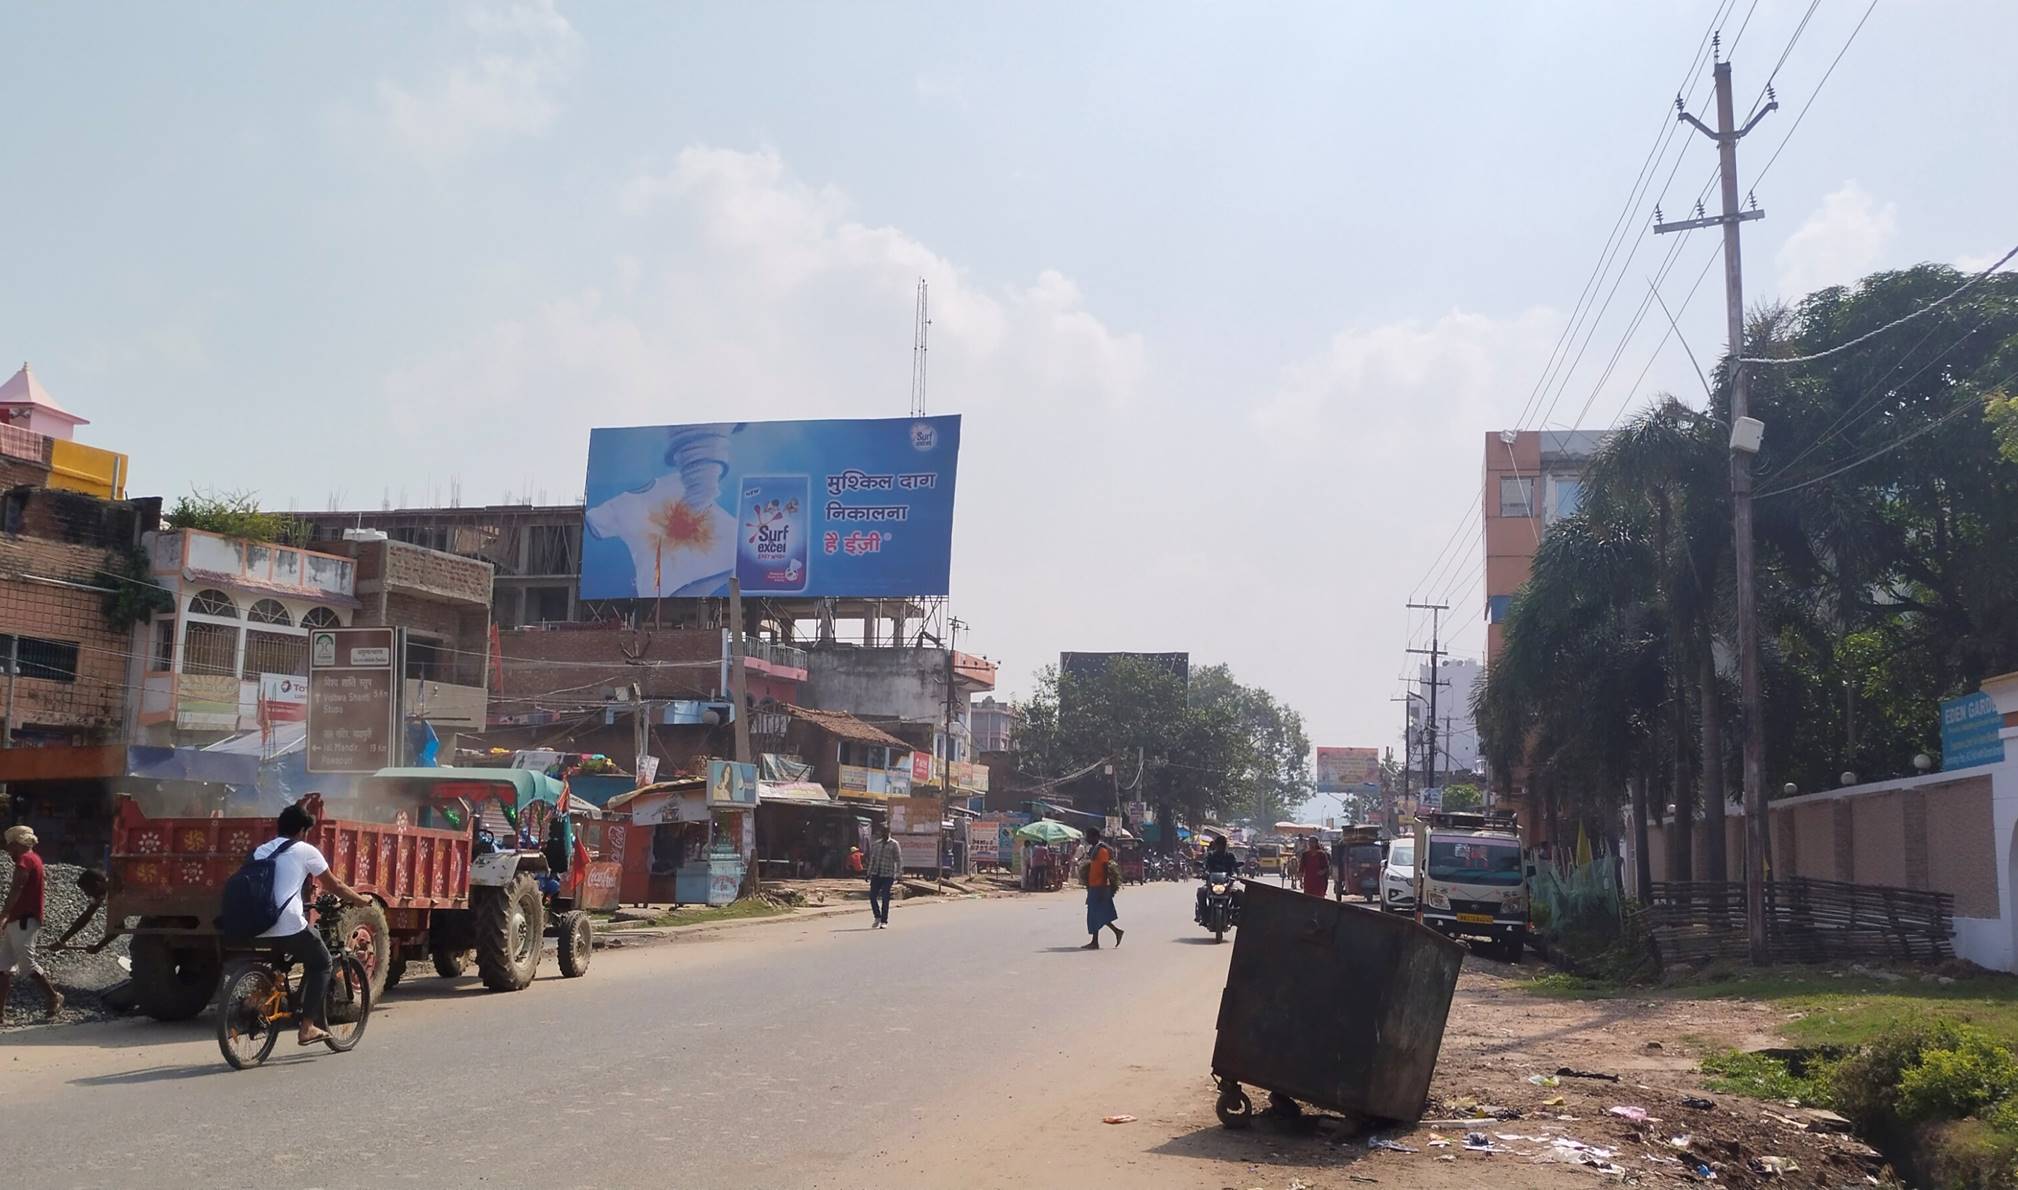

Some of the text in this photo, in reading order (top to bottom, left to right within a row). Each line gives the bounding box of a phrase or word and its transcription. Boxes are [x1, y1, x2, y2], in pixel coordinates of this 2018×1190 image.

[916, 431, 933, 441] Surf
[827, 470, 936, 496] मुश्किल दाग
[825, 501, 908, 521] निकालना
[758, 525, 789, 542] Surf
[824, 532, 838, 553] है
[757, 543, 787, 553] excel
[1945, 705, 1966, 725] EDEN
